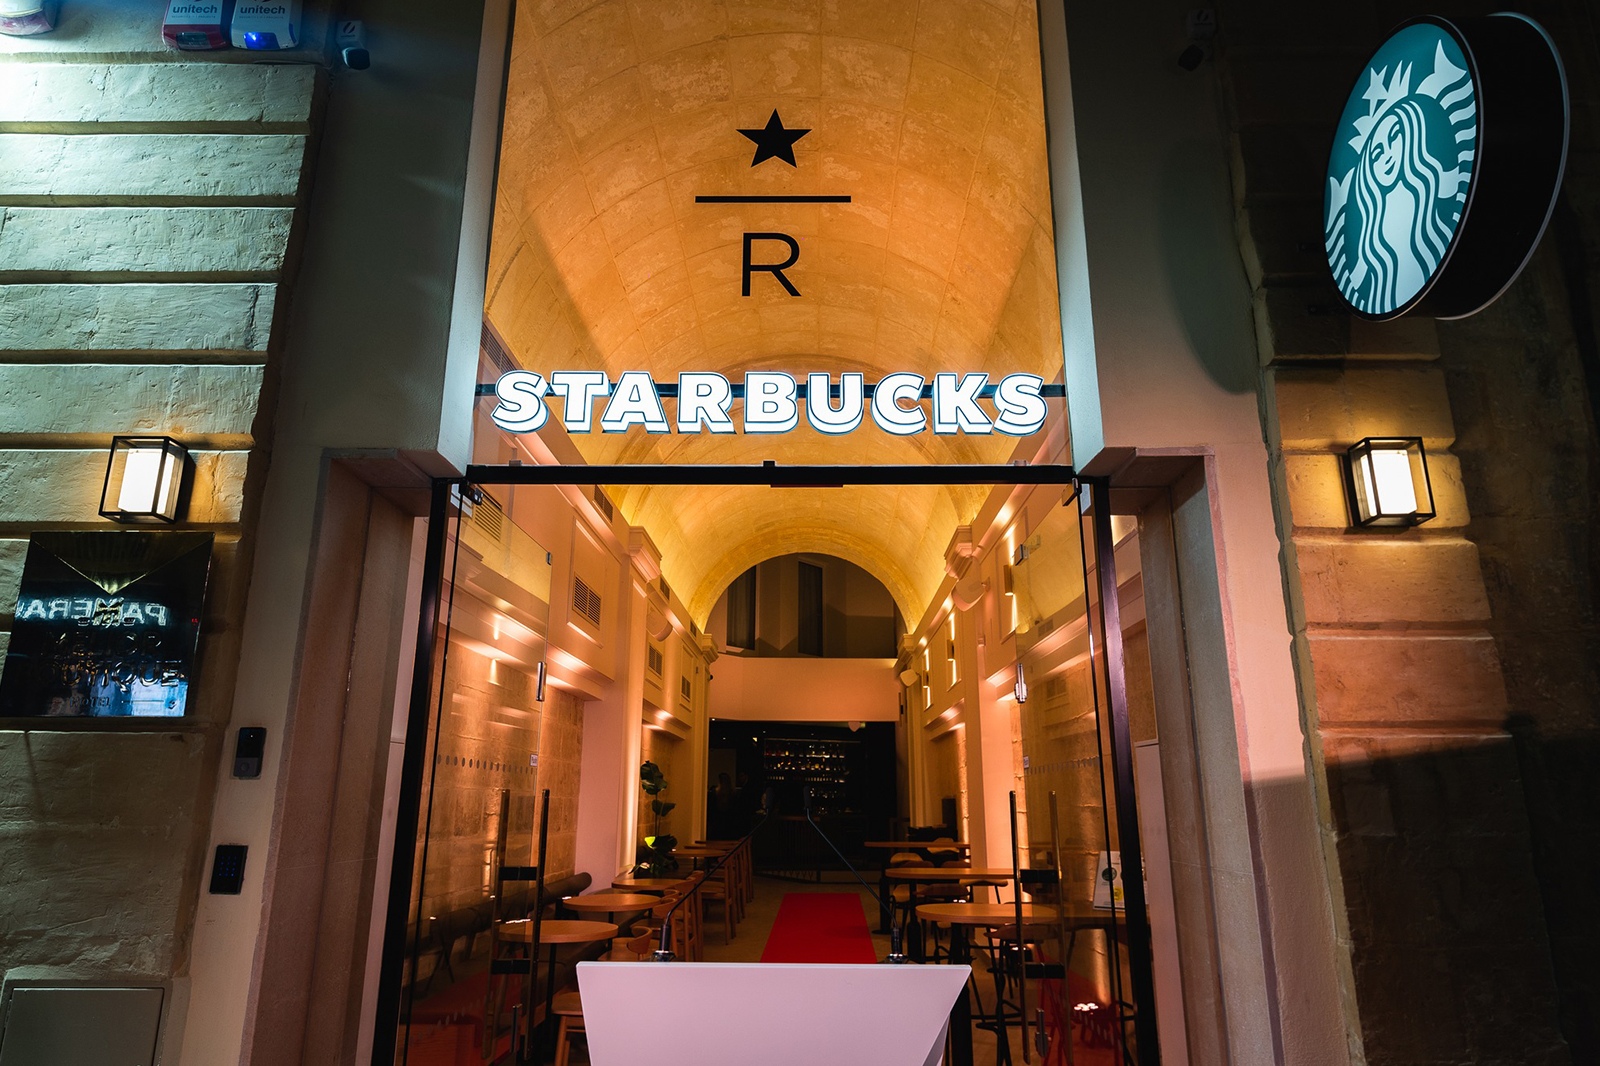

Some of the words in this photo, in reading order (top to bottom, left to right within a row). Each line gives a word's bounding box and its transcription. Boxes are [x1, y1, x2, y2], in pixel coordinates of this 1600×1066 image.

[172, 4, 218, 14] unitech
[240, 5, 286, 14] unitech
[741, 232, 802, 297] R
[491, 370, 1048, 436] STARBUCKS
[22, 659, 183, 692] OUTIQUE
[69, 696, 111, 707] HOTEL
